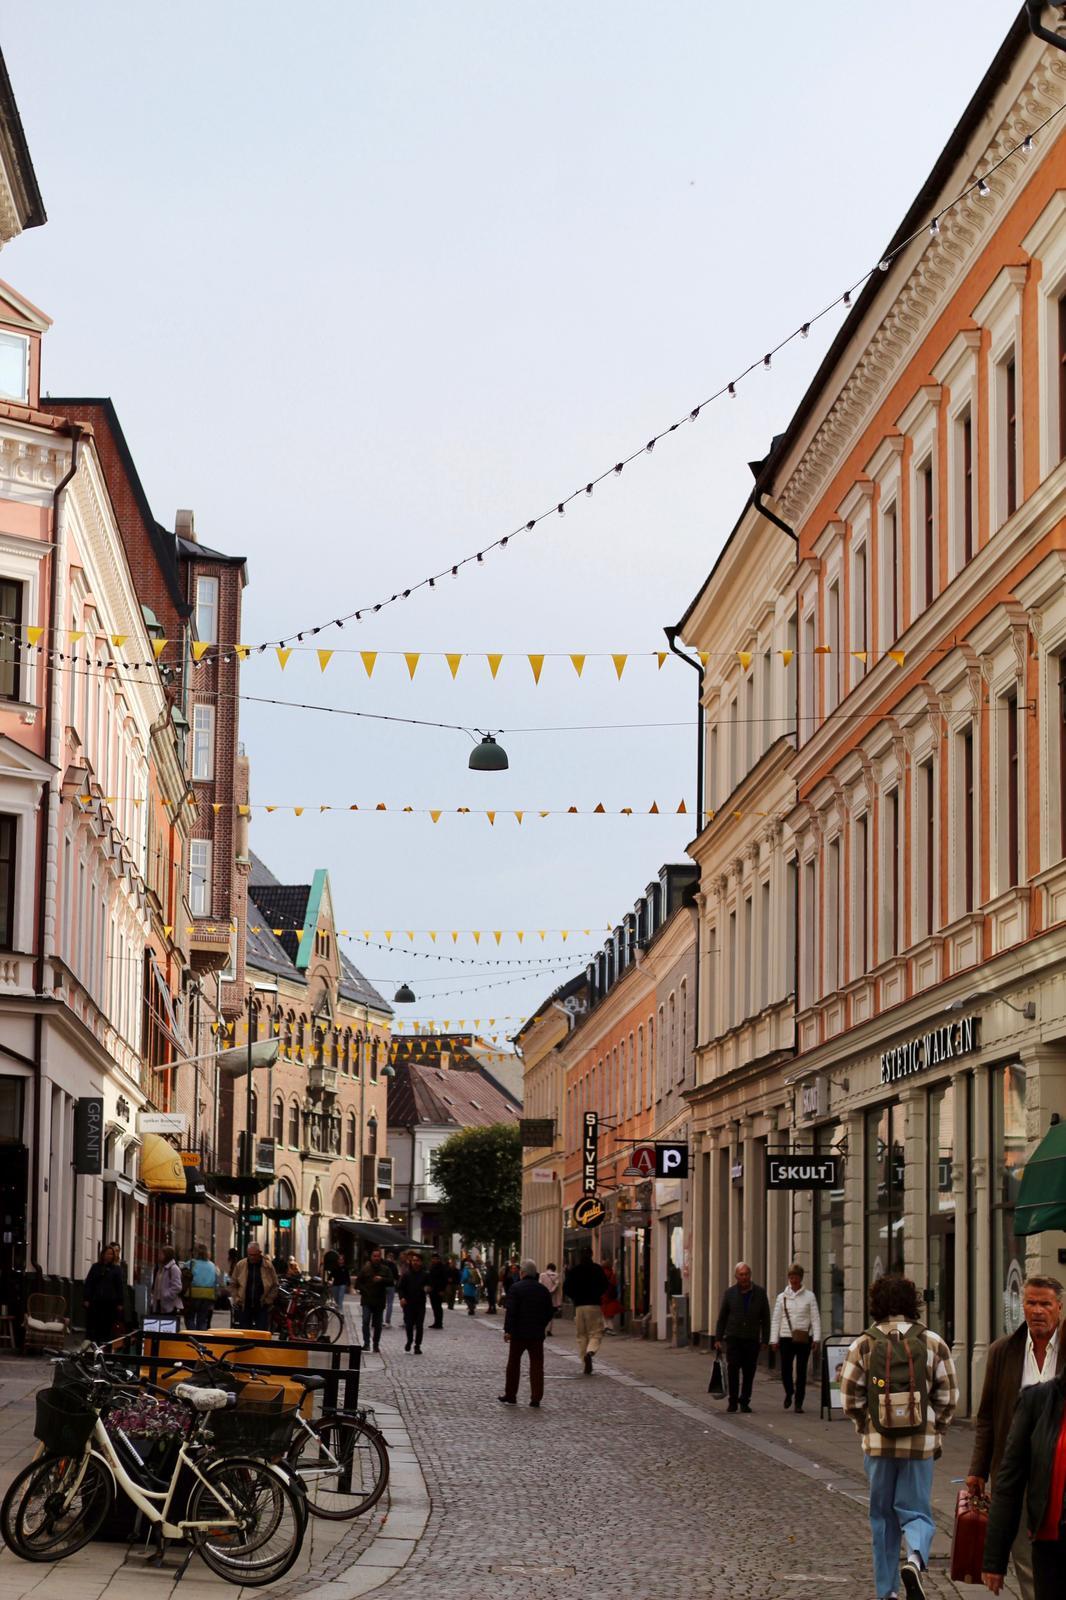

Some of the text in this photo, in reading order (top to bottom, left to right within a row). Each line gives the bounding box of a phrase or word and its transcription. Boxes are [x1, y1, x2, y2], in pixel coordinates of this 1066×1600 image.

[880, 1039, 919, 1084] ESTETIC
[87, 1102, 100, 1162] GRANIT
[585, 1113, 596, 1190] SILVER
[638, 1150, 652, 1169] A
